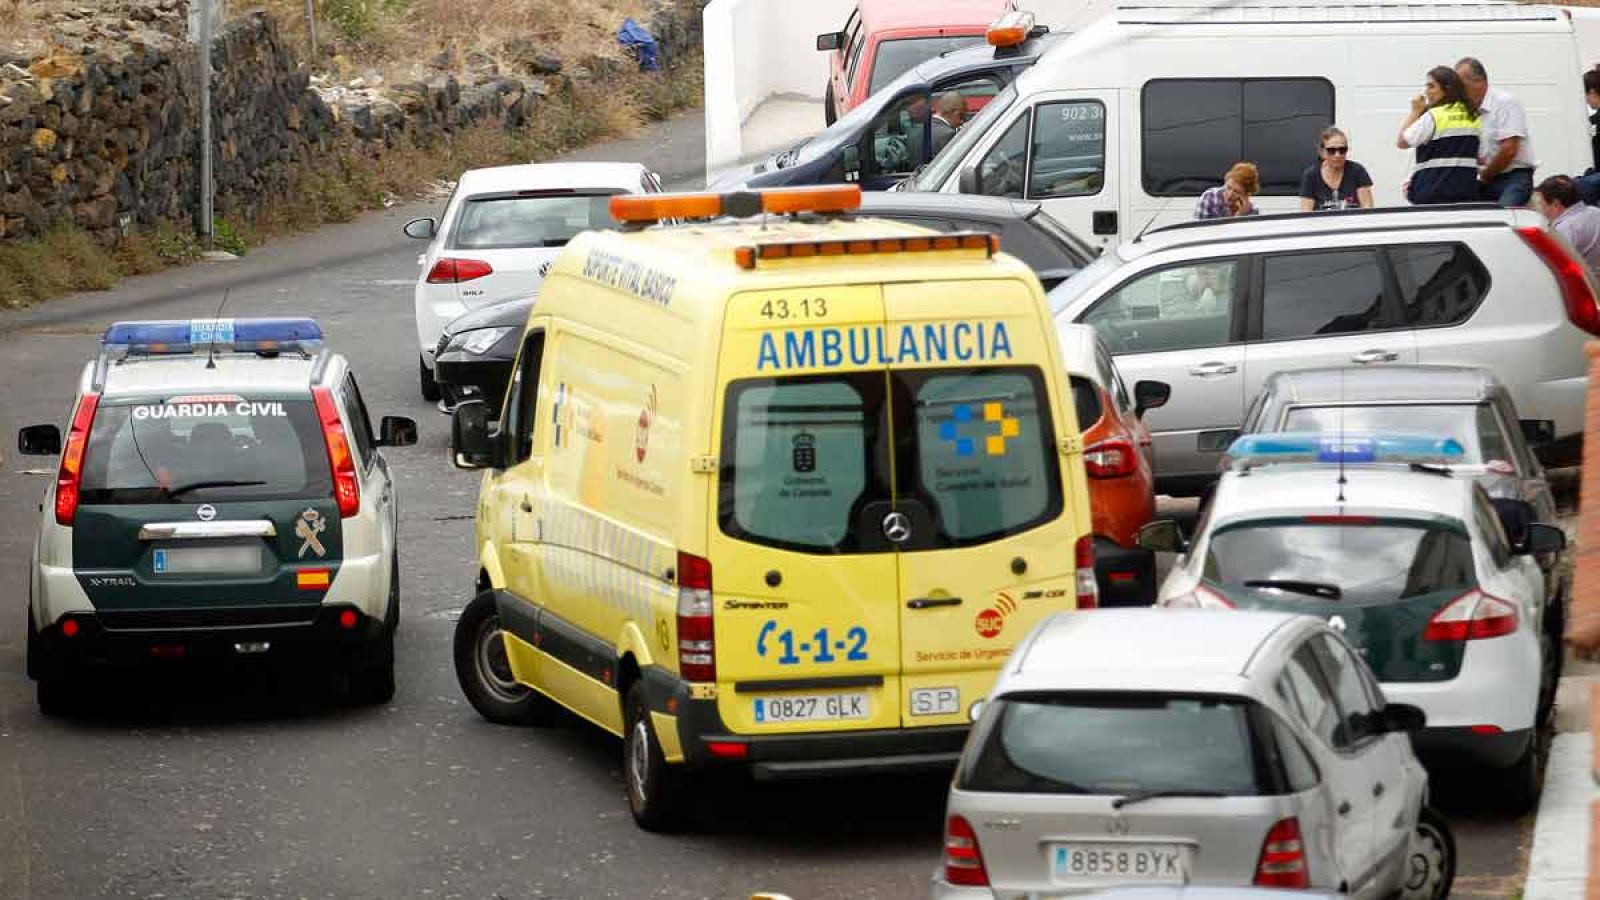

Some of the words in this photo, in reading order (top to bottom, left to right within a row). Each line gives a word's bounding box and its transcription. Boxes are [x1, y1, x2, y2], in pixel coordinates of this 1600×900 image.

[1062, 106, 1087, 120] 902
[761, 299, 828, 320] 43.13
[757, 321, 1013, 370] AMBULANCIA
[133, 404, 228, 419] GUARDIA
[235, 402, 288, 417] CIVIL
[976, 617, 1001, 630] SUC
[778, 626, 868, 664] 1-1-2
[769, 699, 816, 719] 0827
[826, 696, 862, 717] GLK
[1072, 851, 1128, 873] 8858
[1135, 853, 1178, 873] BYK
